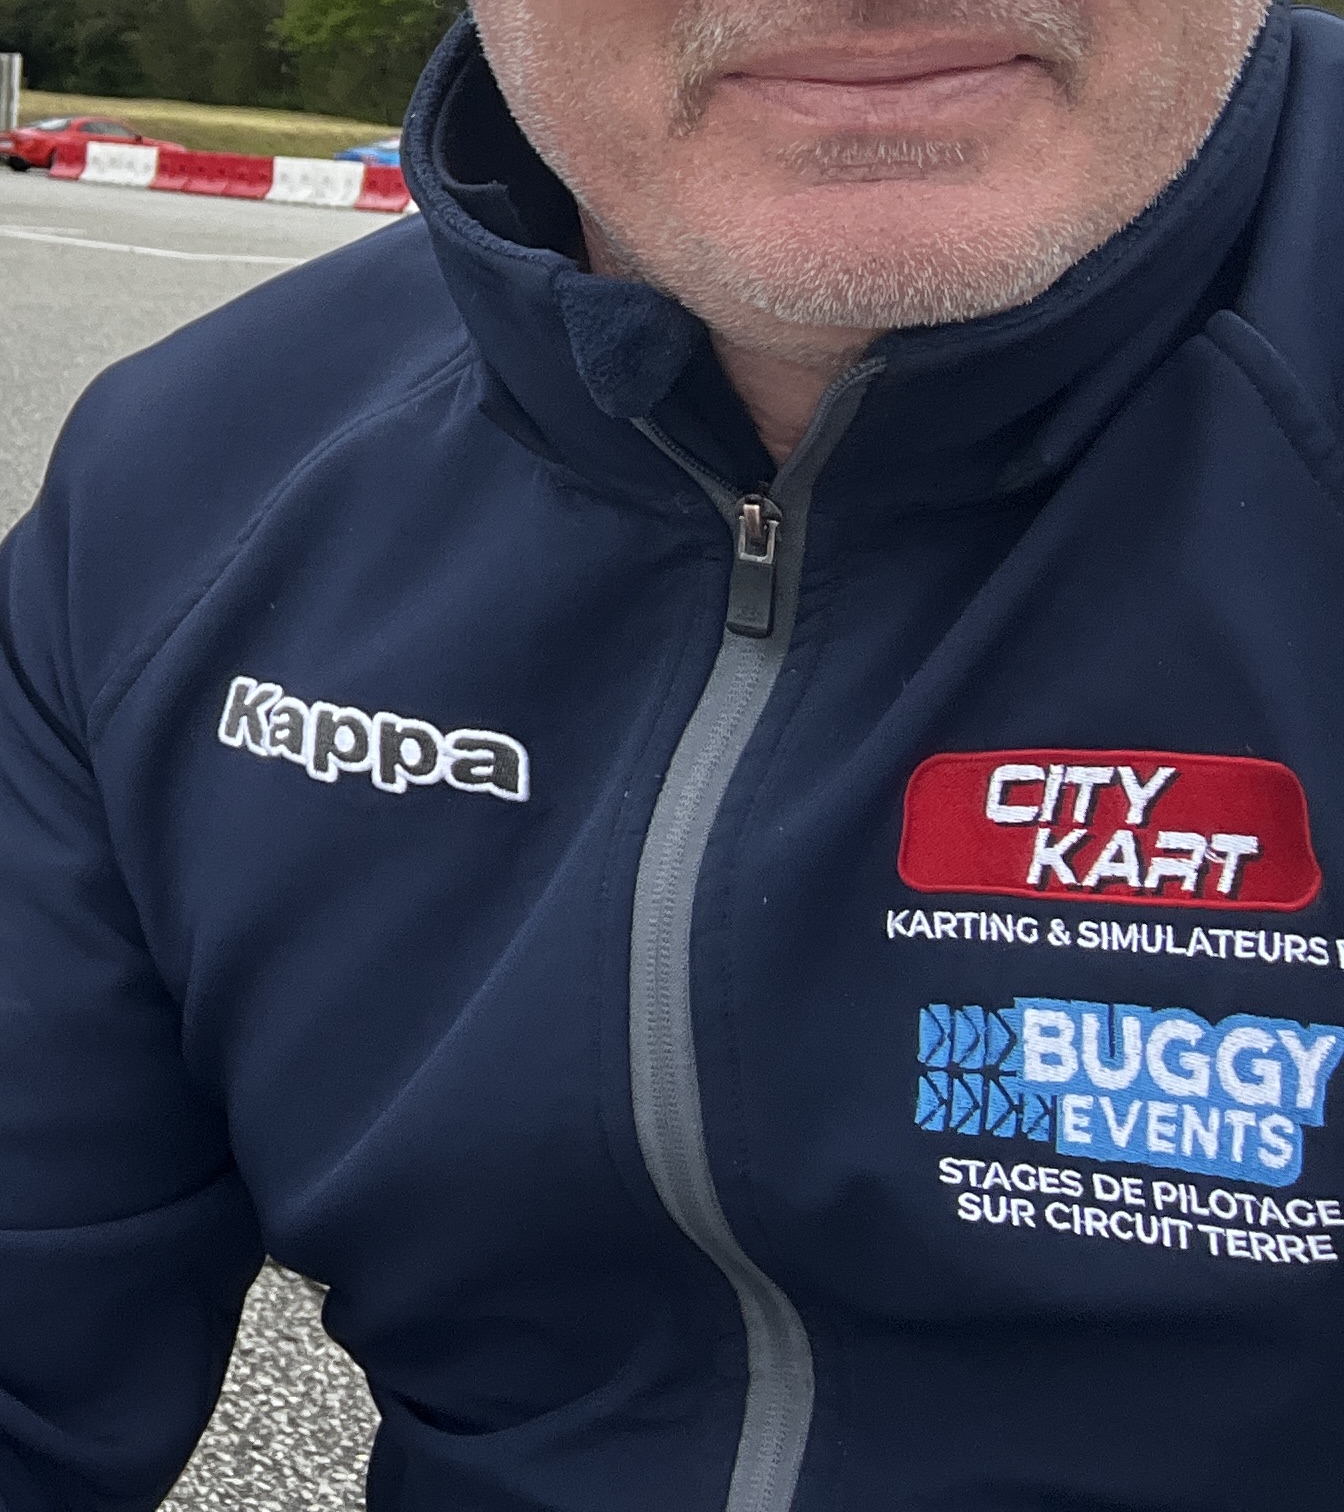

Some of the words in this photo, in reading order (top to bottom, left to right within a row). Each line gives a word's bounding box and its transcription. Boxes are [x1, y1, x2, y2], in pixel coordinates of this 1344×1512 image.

[217, 674, 531, 803] Kappa
[985, 763, 1180, 826] CITY
[1026, 827, 1261, 896] KART
[886, 908, 1039, 946] KARTING
[1046, 918, 1072, 946] &
[1076, 919, 1330, 967] SIMULATEURS
[1022, 1007, 1338, 1110] BUGGY
[1061, 1093, 1296, 1170] EVENTS
[937, 1156, 1085, 1198] STAGES
[1092, 1172, 1147, 1207] DE
[1152, 1179, 1344, 1230] PILOTAGE
[957, 1191, 1037, 1229] SUR
[1044, 1202, 1193, 1252] CIRCUIT
[1196, 1223, 1339, 1265] TERRE
